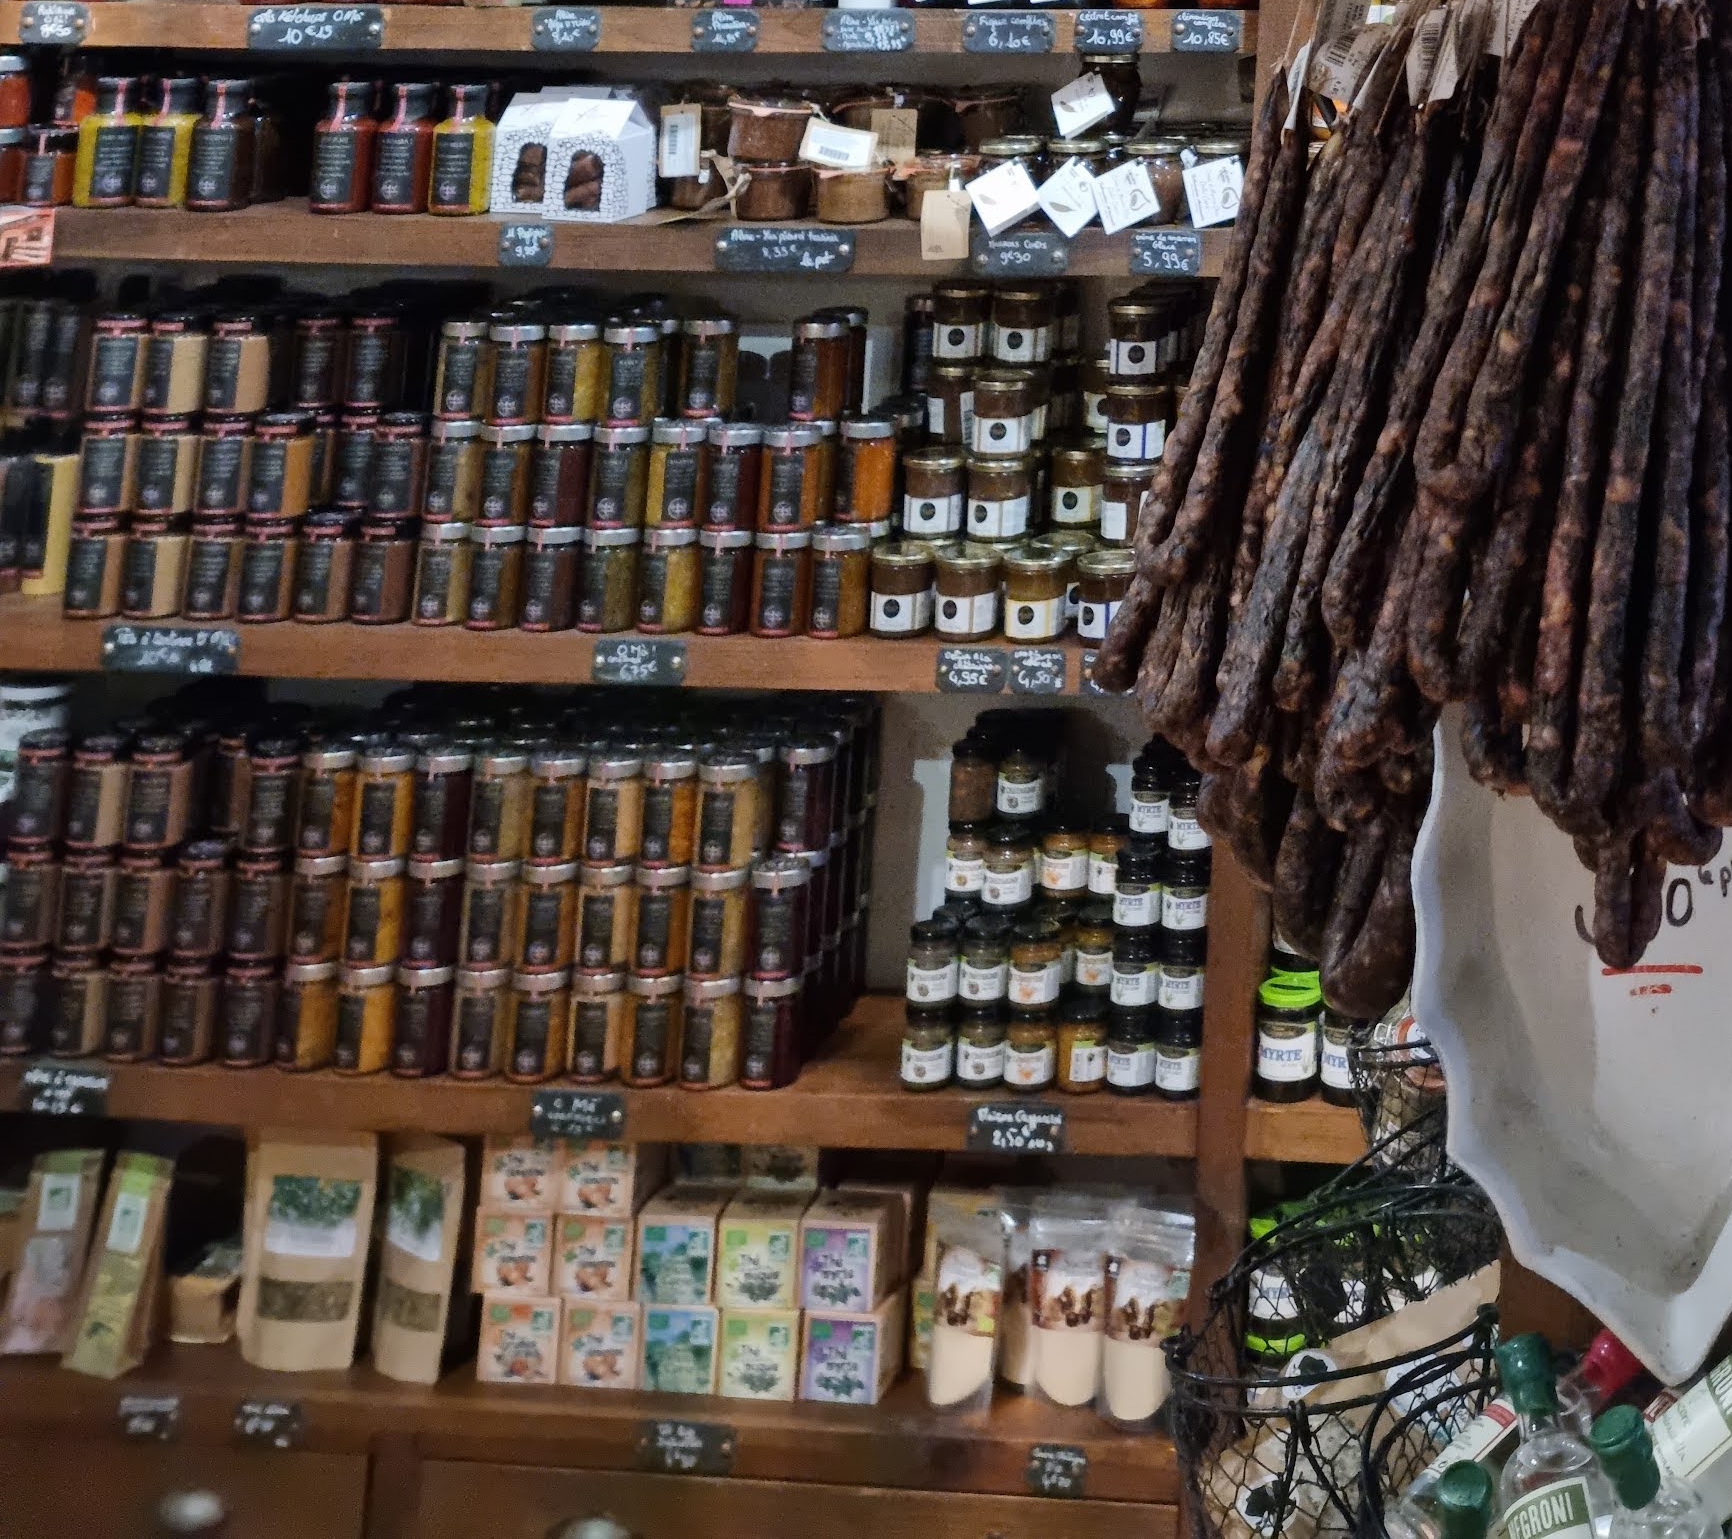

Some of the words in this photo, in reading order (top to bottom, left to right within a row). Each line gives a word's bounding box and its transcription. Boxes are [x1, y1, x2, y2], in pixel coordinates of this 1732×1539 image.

[1085, 27, 1134, 46] 10,99€
[1182, 31, 1229, 47] 10,85€
[1142, 251, 1189, 271] 5,99€
[1260, 1046, 1303, 1061] MYRTE
[1323, 1052, 1347, 1069] MYR
